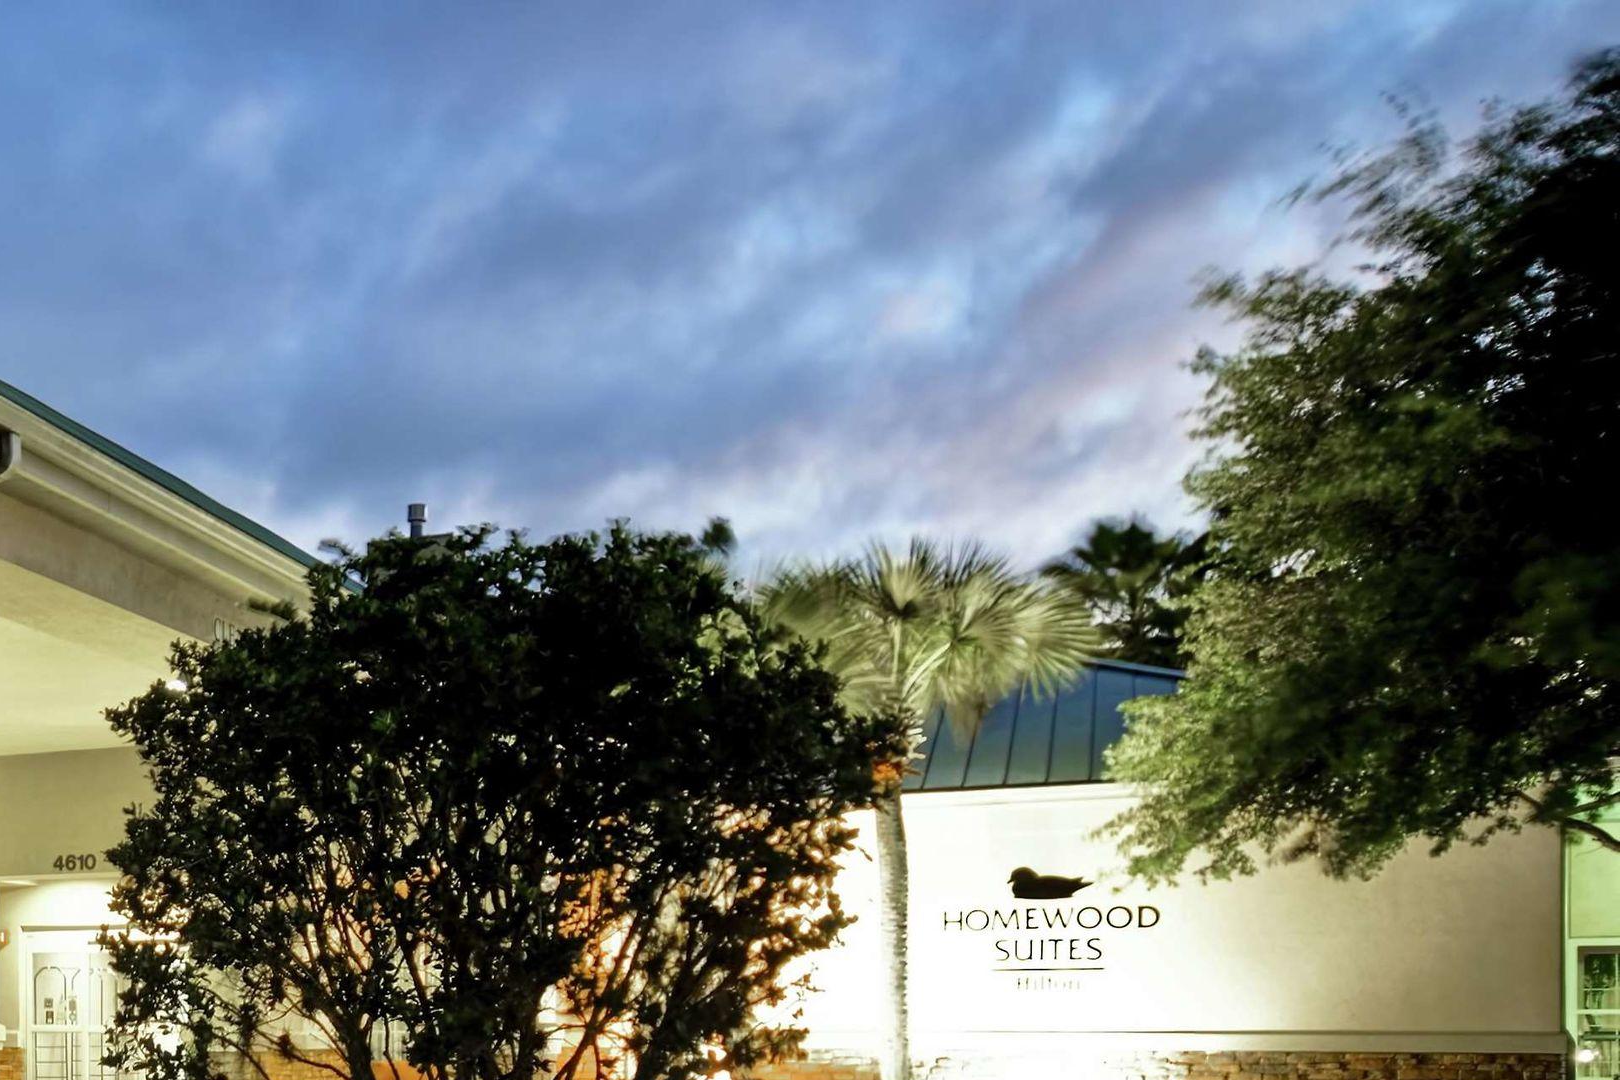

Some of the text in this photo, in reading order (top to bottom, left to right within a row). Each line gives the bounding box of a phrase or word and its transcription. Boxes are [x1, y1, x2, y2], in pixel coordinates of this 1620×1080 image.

[53, 854, 96, 871] 4610
[943, 905, 1161, 931] HOMEWOOD
[994, 938, 1103, 961] SUITES
